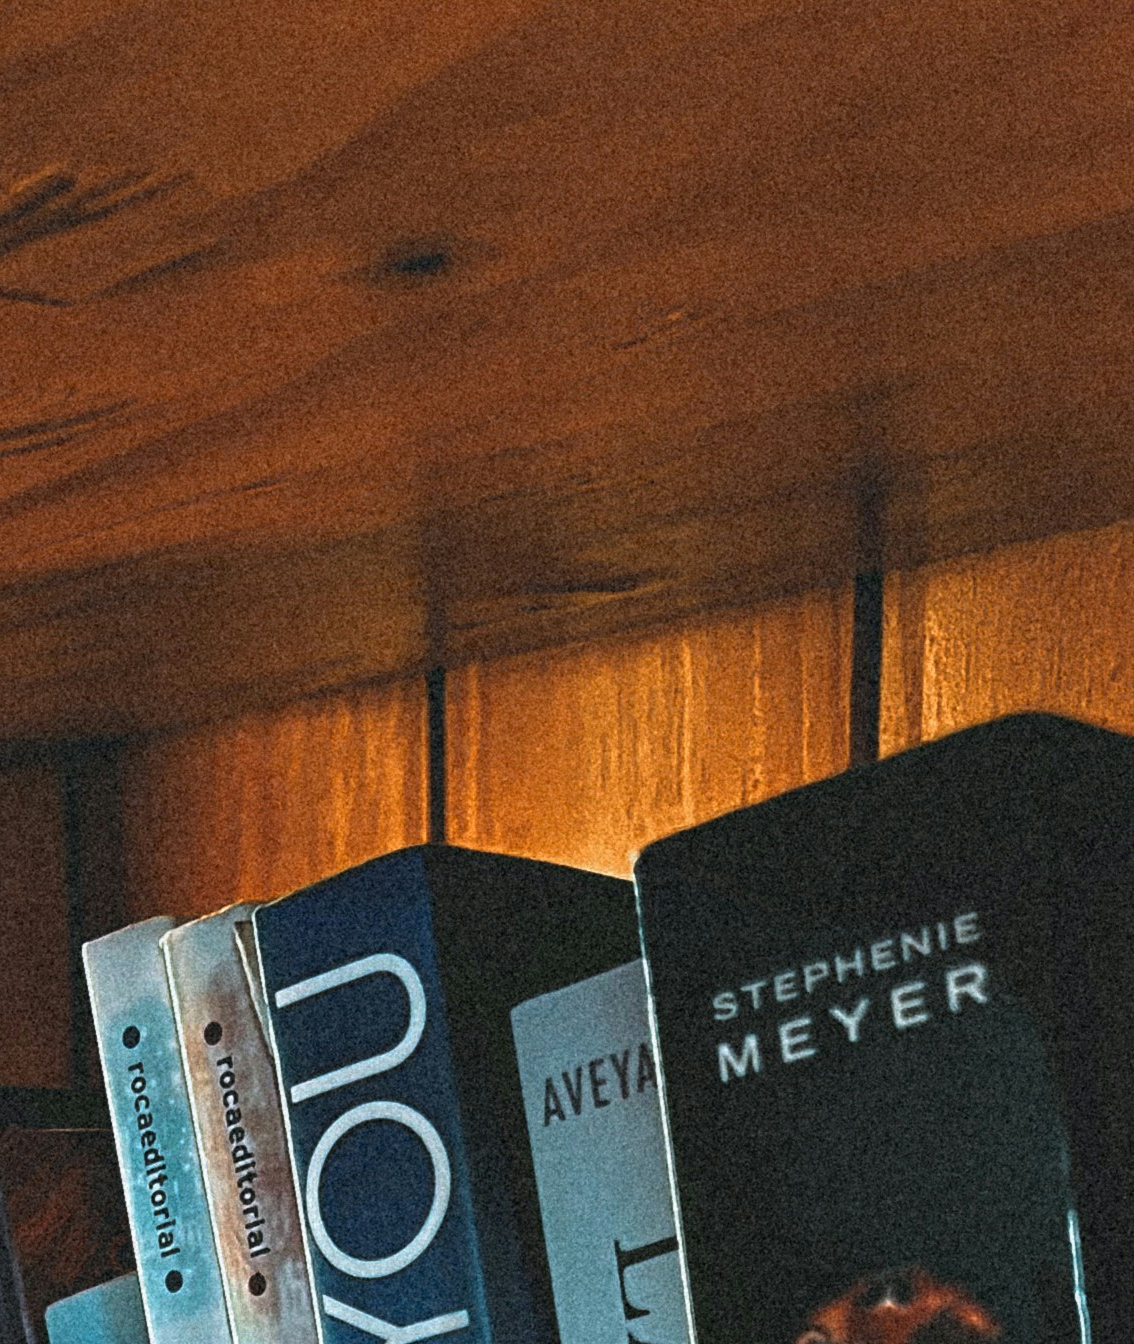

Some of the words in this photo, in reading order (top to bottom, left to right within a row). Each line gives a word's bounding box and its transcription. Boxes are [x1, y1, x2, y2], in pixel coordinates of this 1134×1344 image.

[711, 910, 983, 1022] STEPHENIE
[717, 962, 990, 1084] MEYER
[129, 1060, 180, 1259] rocaeditorial
[215, 1054, 268, 1259] rocaeditorial
